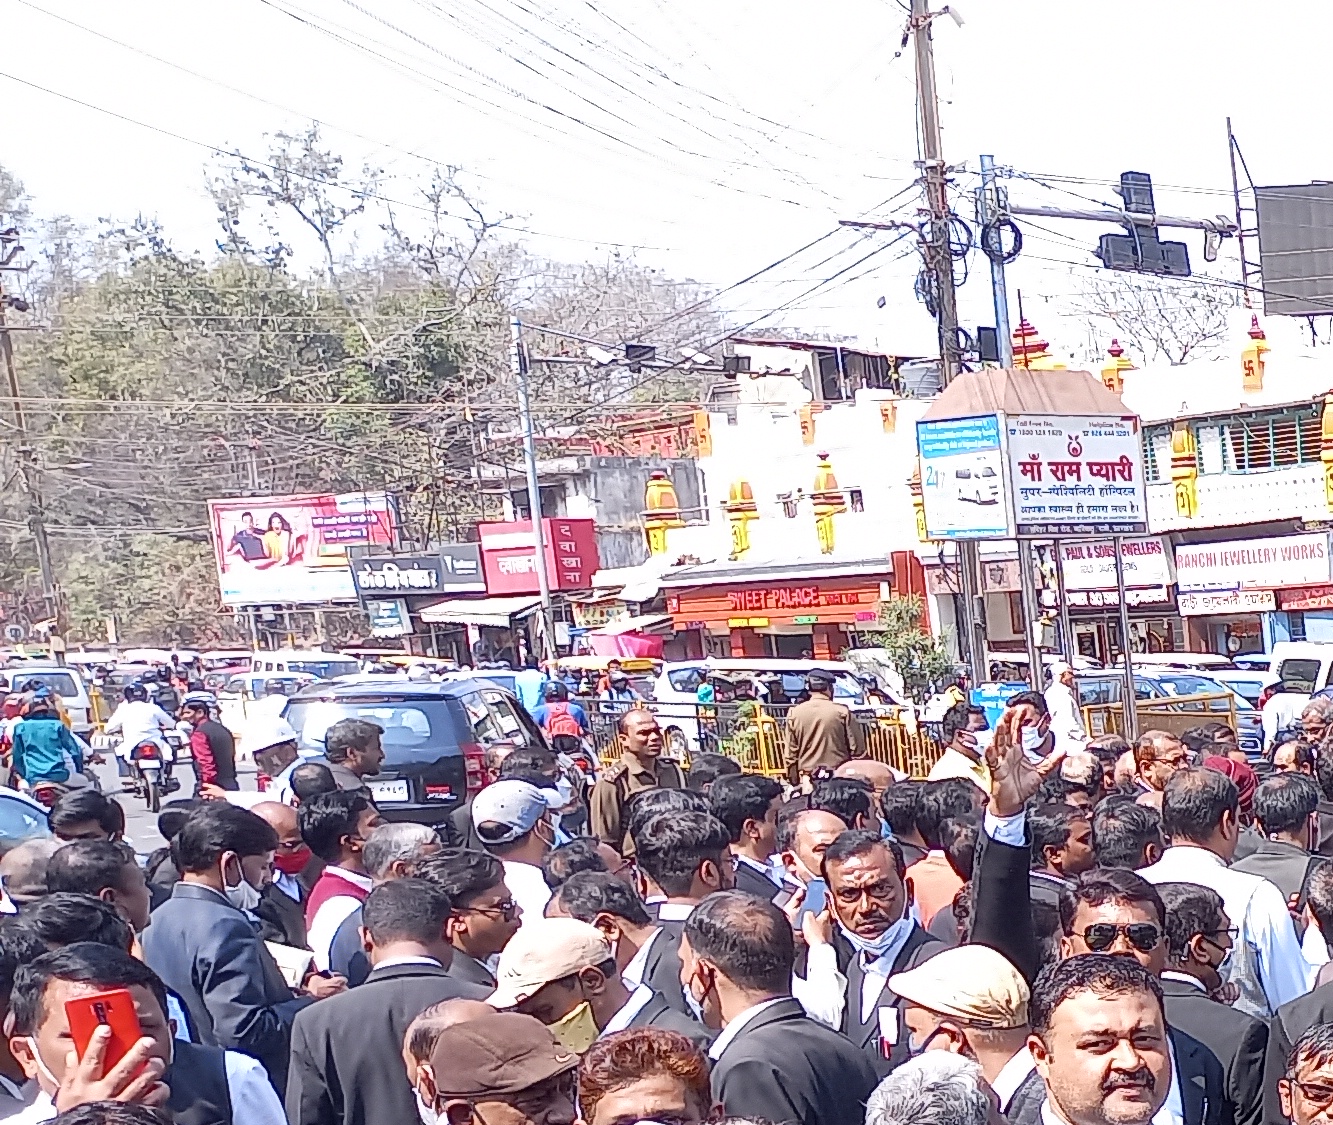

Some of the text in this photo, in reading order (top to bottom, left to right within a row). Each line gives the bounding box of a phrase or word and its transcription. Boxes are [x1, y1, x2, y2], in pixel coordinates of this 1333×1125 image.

[1018, 453, 1133, 482] माँ राम प्यारी
[1066, 546, 1085, 560] PAUL
[1087, 546, 1093, 559] &
[1120, 541, 1162, 557] EWELLERS
[1177, 542, 1324, 569] RANCHI JEWELLERY WORKS
[727, 589, 768, 611] SWEET
[773, 586, 819, 609] PALACE
